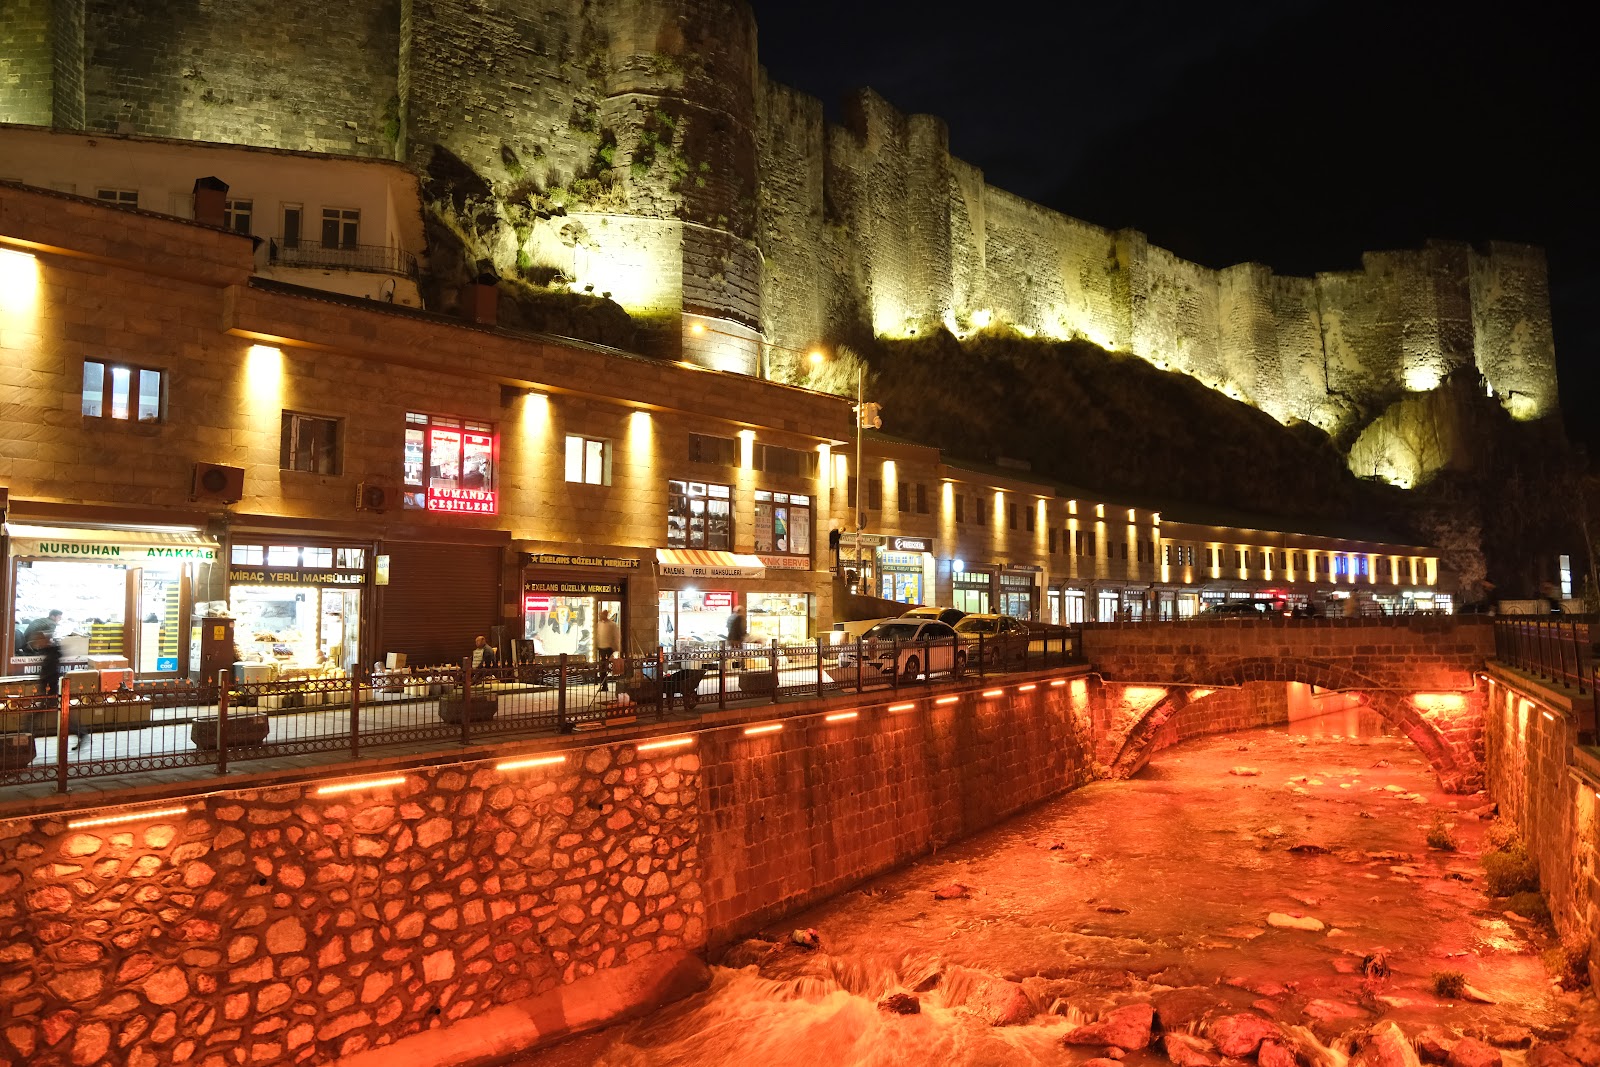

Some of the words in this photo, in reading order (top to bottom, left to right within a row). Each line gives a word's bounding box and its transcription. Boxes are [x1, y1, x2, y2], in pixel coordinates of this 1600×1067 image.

[433, 488, 493, 501] KUMANDA
[429, 499, 494, 512] ÇEŞİTLERİ
[39, 542, 120, 556] NURDUHAN
[571, 557, 603, 567] GÜZELLİK
[604, 559, 632, 568] MERKEZİ
[229, 570, 264, 583] MİRAÇ
[270, 571, 299, 582] YERLİ
[302, 572, 366, 584] MAHSÜLLERİ
[531, 584, 559, 592] EXELANS
[560, 584, 586, 592] GÜZELLİK
[587, 585, 611, 593] MERKEZİ
